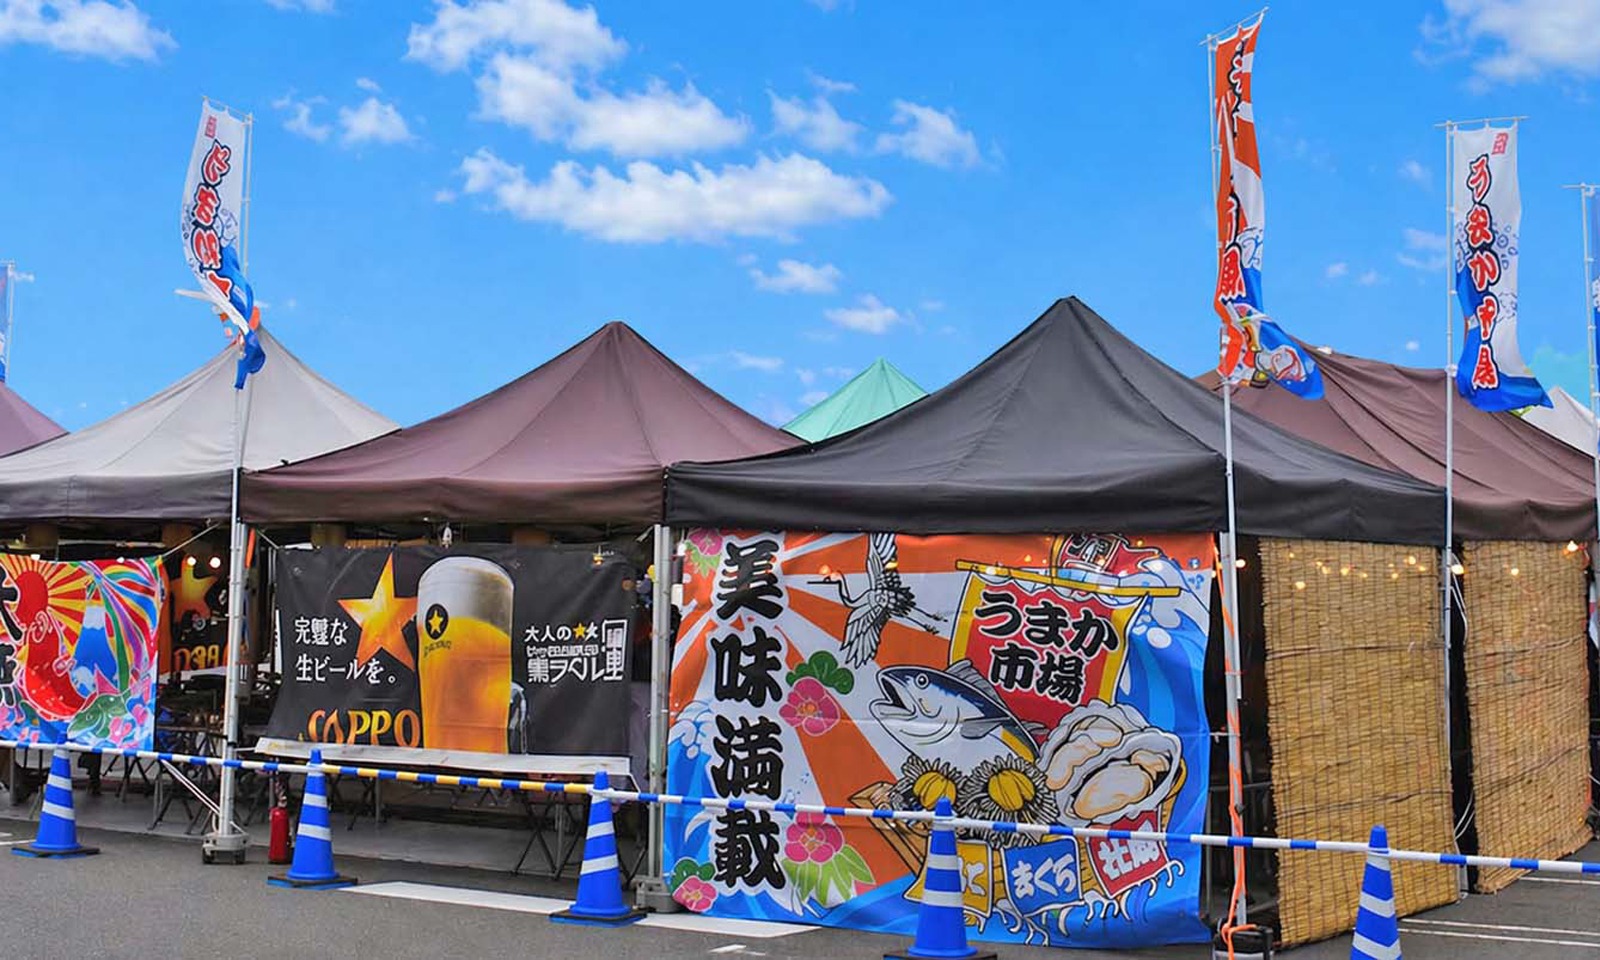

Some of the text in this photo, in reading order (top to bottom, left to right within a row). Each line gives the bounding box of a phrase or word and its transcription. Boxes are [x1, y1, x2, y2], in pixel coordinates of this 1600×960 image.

[975, 591, 1119, 658] うまか
[295, 653, 397, 685] 生ビールを。
[991, 643, 1085, 705] 市場
[711, 540, 786, 888] 美味満載
